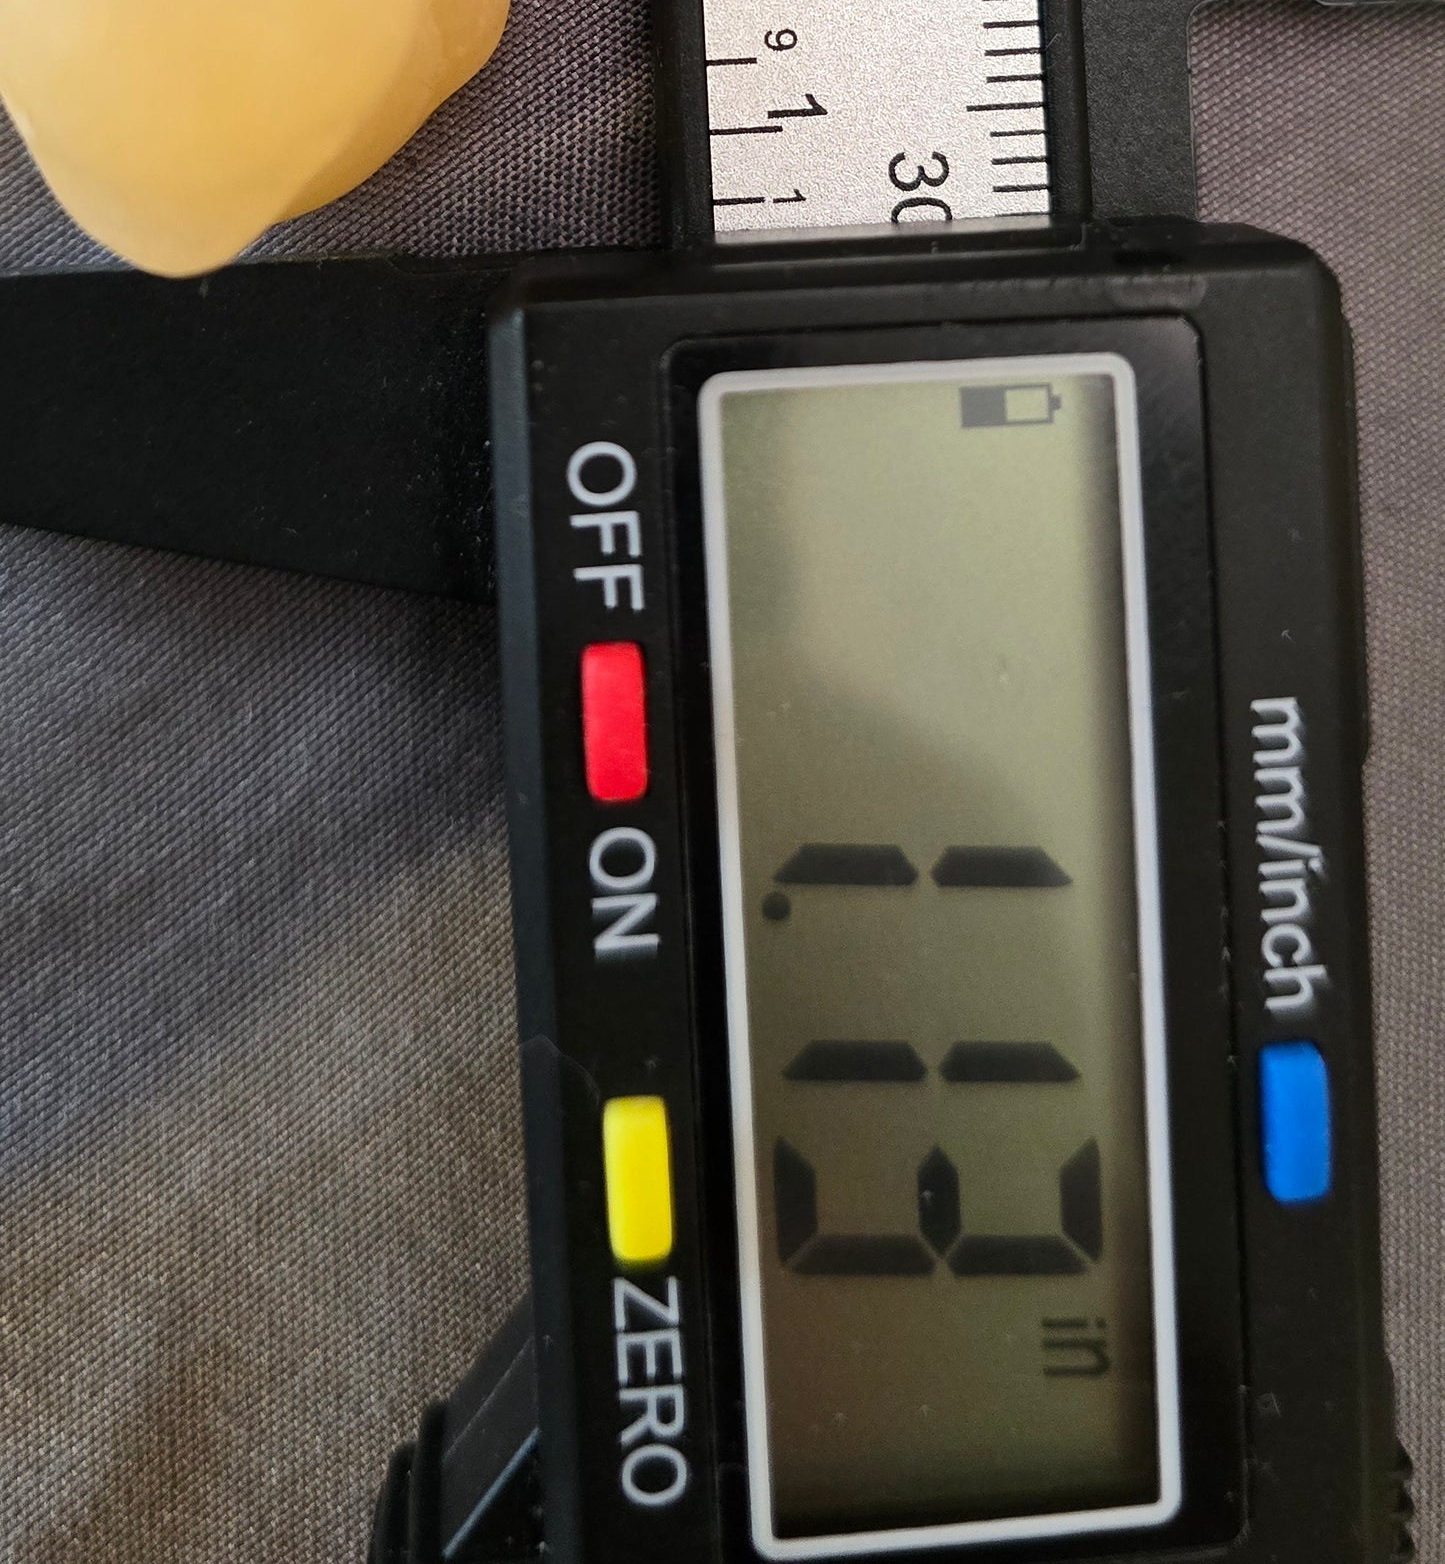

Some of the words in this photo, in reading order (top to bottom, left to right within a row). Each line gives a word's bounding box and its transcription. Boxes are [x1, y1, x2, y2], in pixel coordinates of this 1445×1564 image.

[764, 28, 798, 51] 9
[767, 93, 828, 119] 1
[773, 188, 806, 204] 1
[567, 440, 644, 612] OFF
[588, 826, 660, 959] ON
[1251, 697, 1328, 1011] mm/inch
[761, 842, 1103, 1277] 1.13
[1041, 1316, 1110, 1379] in
[613, 1278, 687, 1508] ZERO
